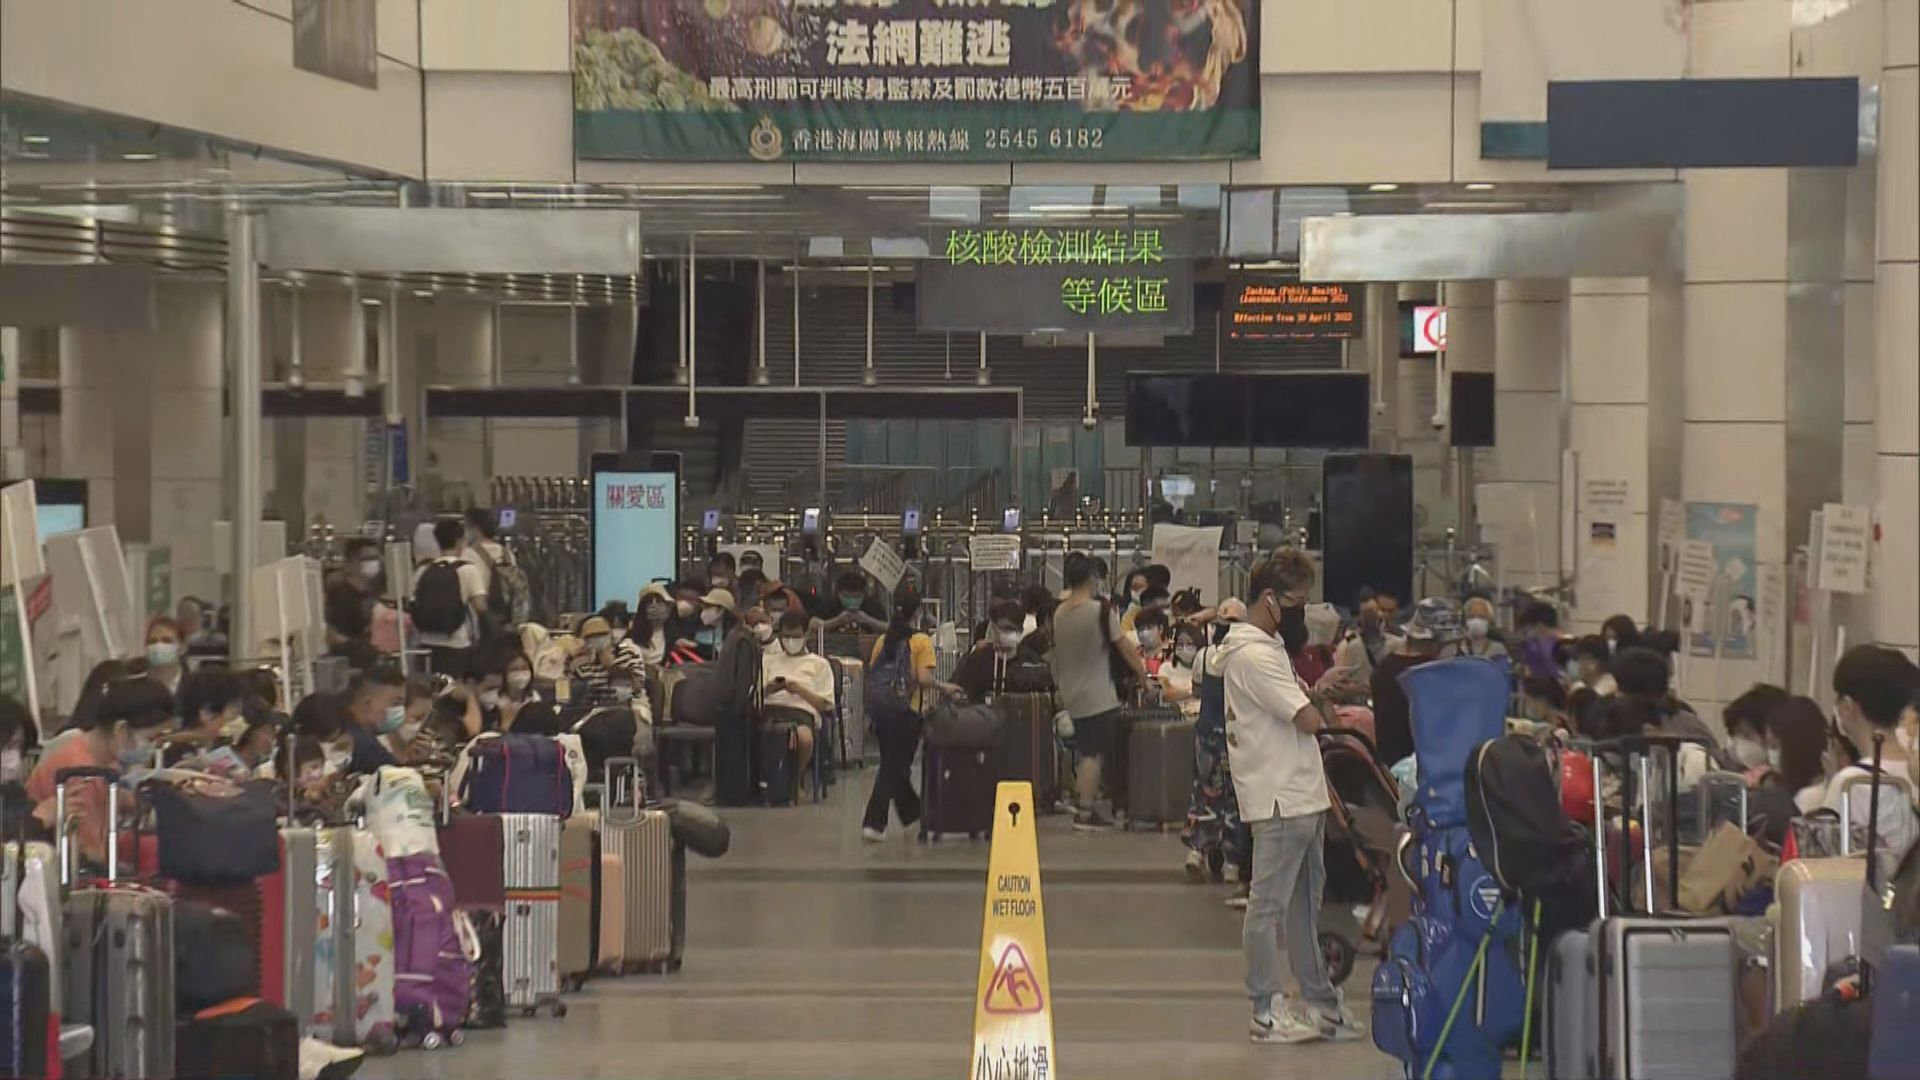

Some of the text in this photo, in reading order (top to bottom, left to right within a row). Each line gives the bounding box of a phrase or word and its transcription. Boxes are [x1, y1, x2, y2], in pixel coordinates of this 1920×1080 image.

[825, 19, 1010, 66] 法網難逃
[792, 128, 1103, 152] 香港海關舉報熱線 2545 6182
[946, 229, 1163, 266] 核酸檢測結果
[1061, 276, 1169, 314] 等候區
[606, 484, 666, 509] 關愛區
[998, 874, 1031, 893] CAUTION
[992, 899, 1036, 916] WET FLOOR
[975, 1042, 1049, 1080] 小心地滑
